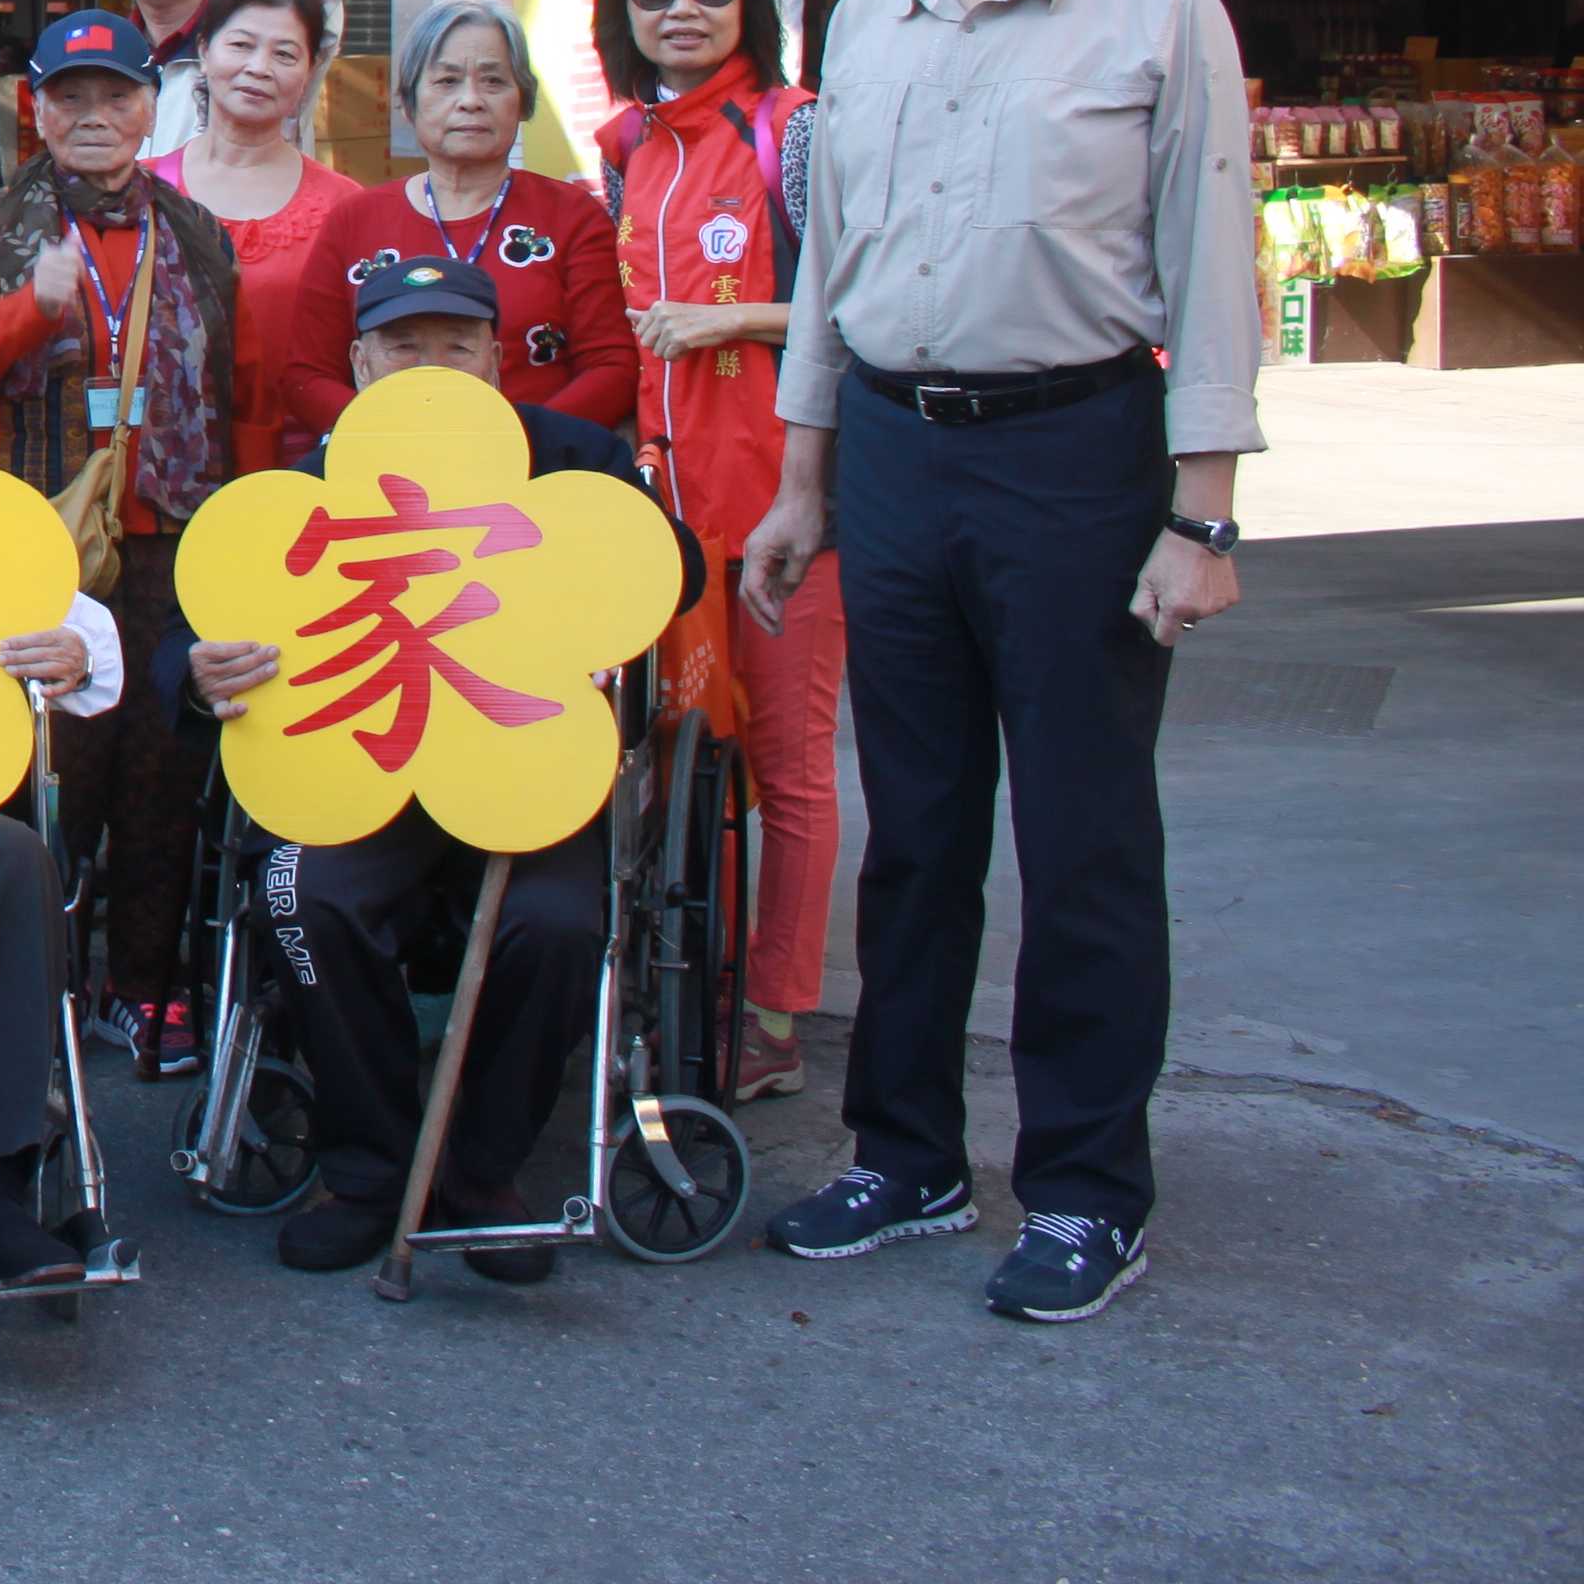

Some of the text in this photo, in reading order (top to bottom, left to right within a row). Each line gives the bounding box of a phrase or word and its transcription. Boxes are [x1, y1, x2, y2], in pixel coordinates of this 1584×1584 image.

[710, 274, 743, 305] 雲
[1281, 282, 1306, 357] 口味
[282, 473, 565, 773] 家
